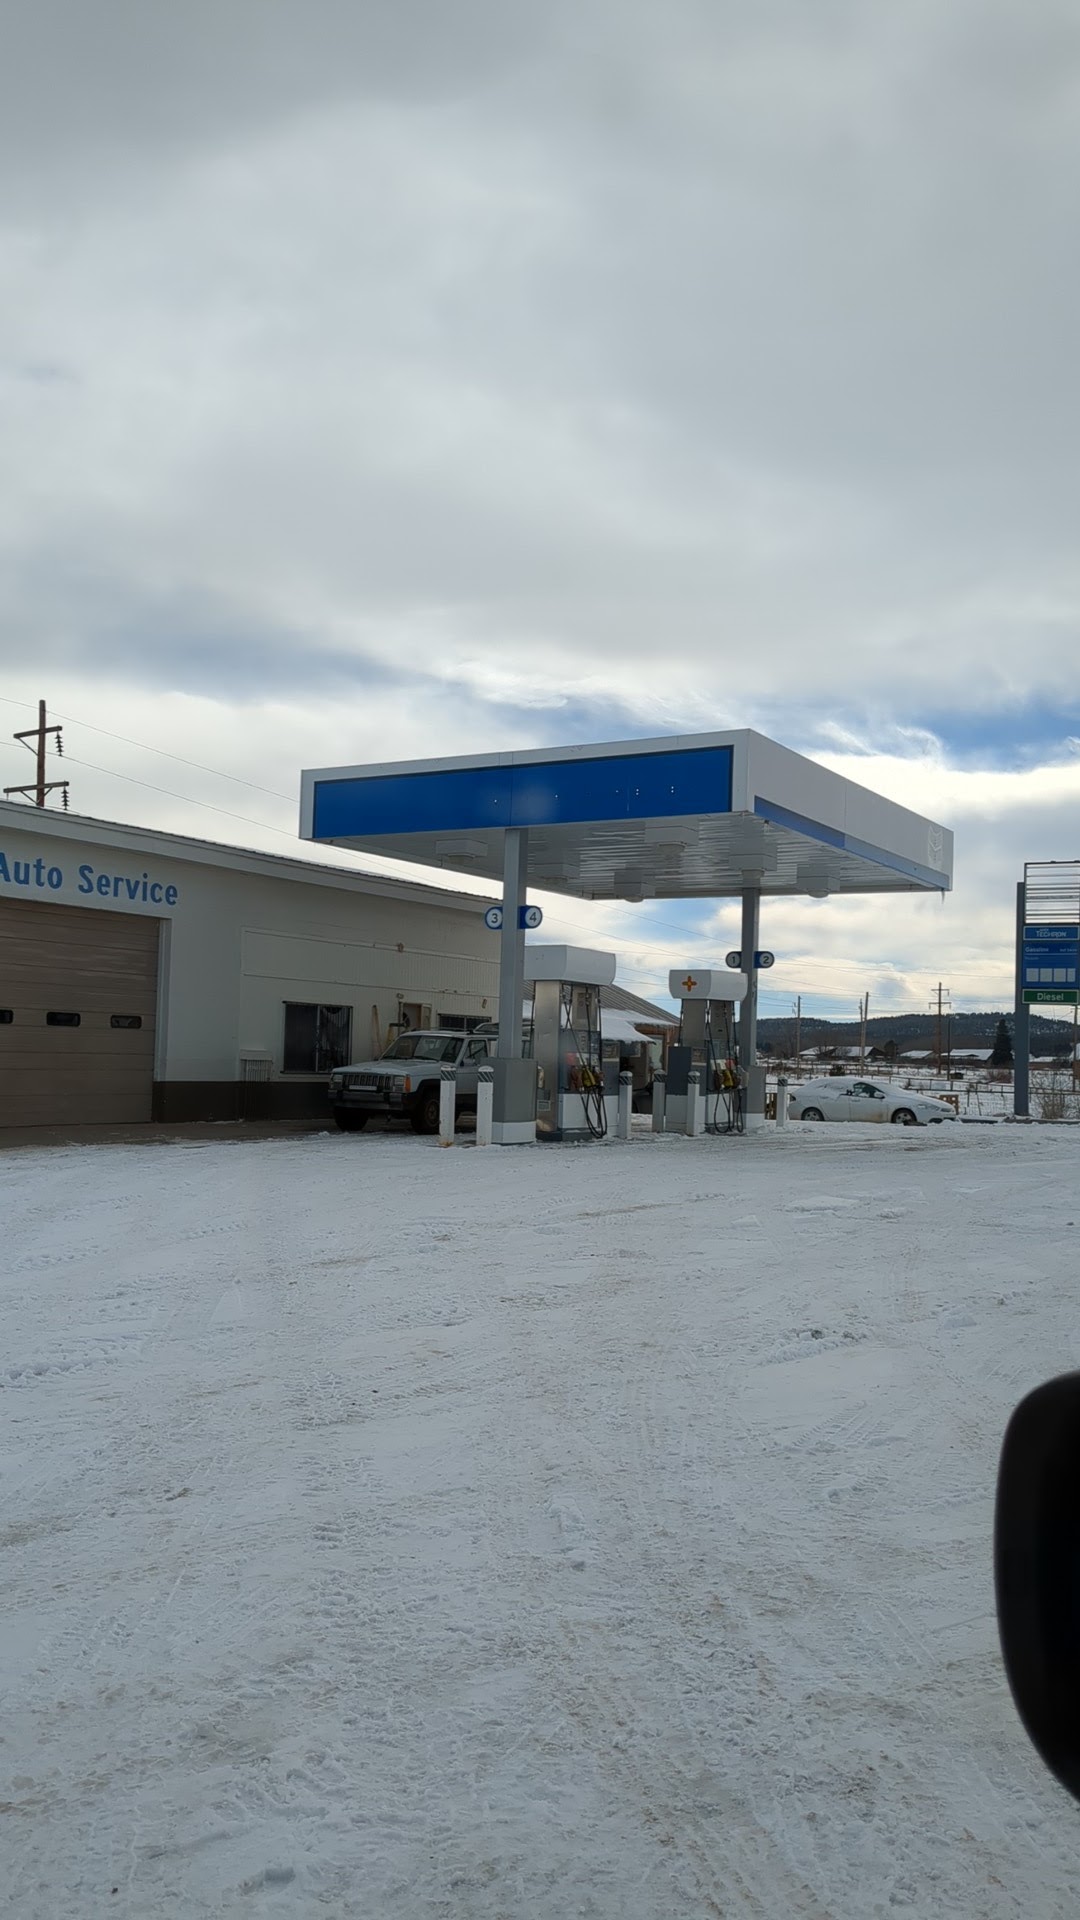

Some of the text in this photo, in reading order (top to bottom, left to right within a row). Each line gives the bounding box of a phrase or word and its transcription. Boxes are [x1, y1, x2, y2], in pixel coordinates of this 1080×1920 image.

[0, 852, 178, 905] Auto Service
[491, 913, 498, 923] 3
[529, 912, 537, 922] 4
